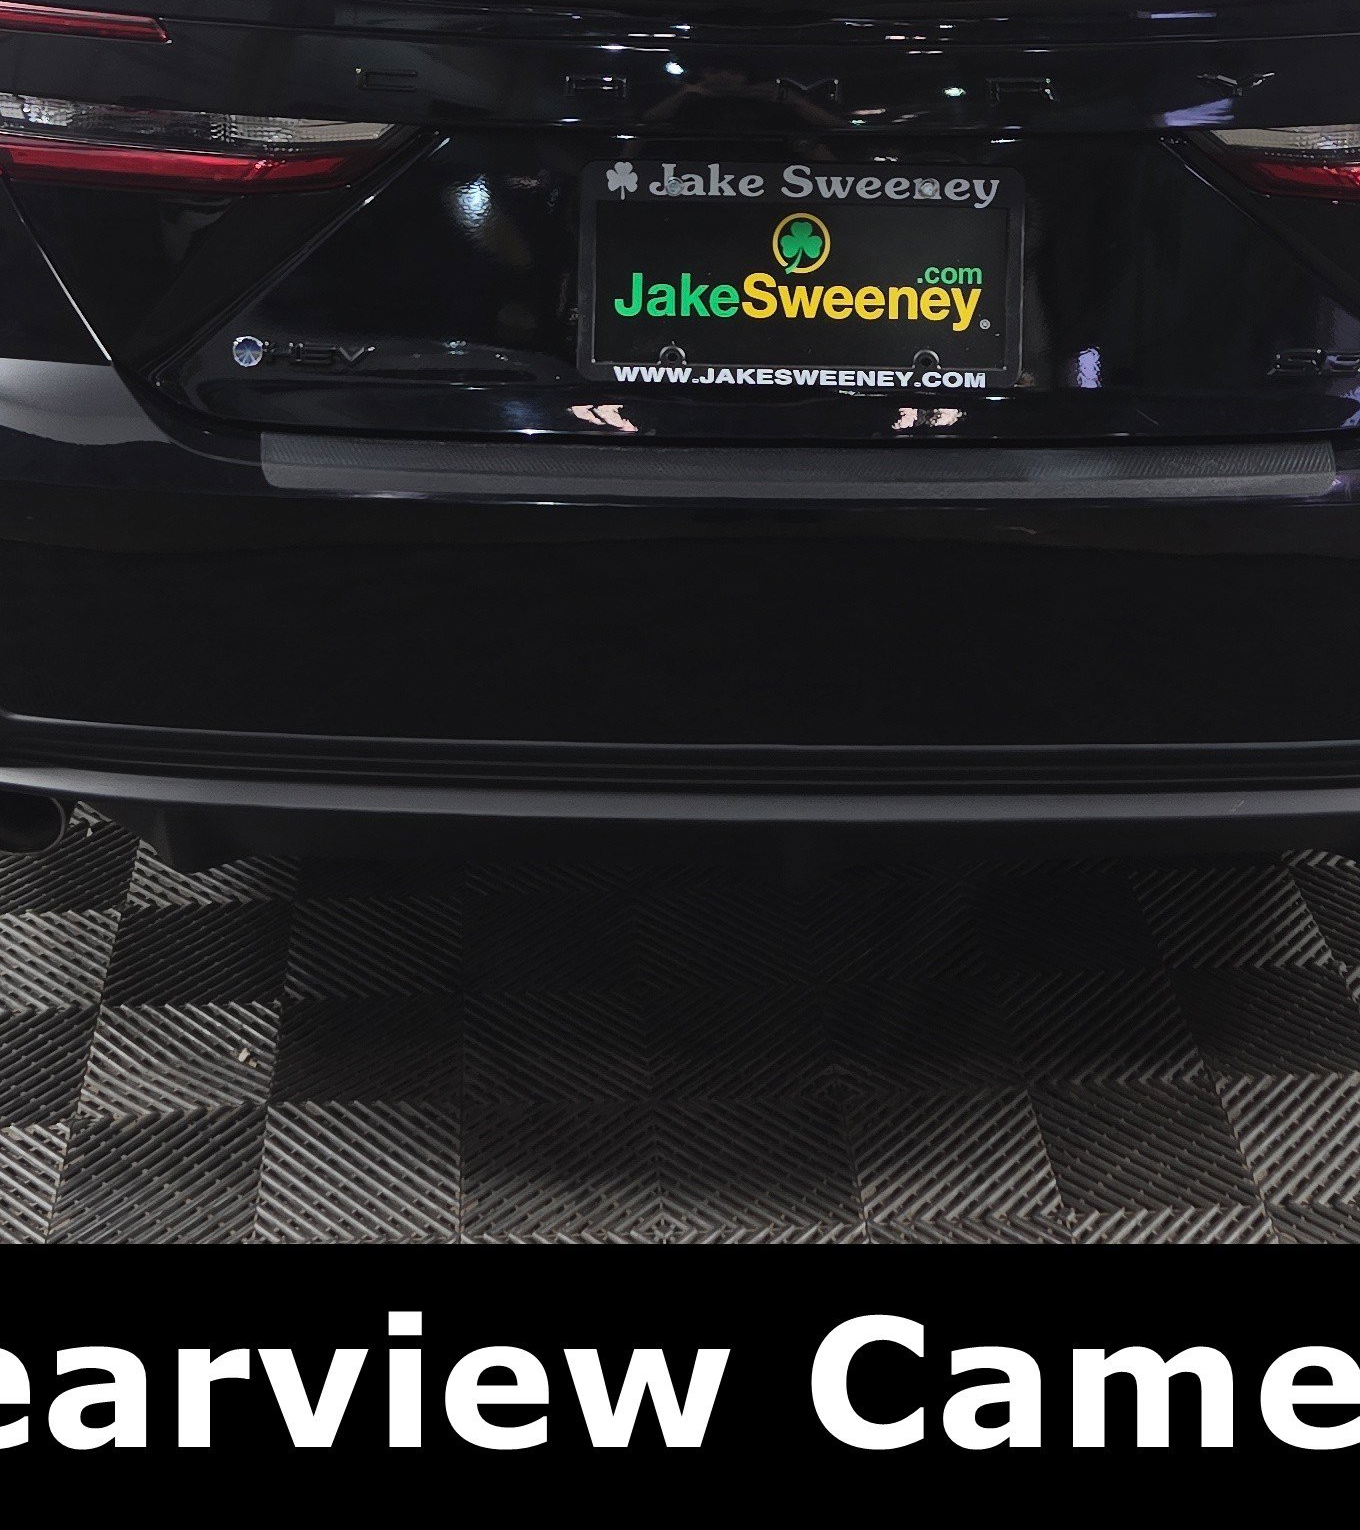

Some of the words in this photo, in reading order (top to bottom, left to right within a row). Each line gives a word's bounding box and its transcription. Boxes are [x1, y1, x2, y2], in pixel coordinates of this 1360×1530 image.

[649, 163, 765, 197] Jake
[781, 165, 1000, 208] Sweeney
[614, 273, 982, 331] JakeSweeney
[613, 366, 987, 389] WWW.JAKESWEENEY.COM
